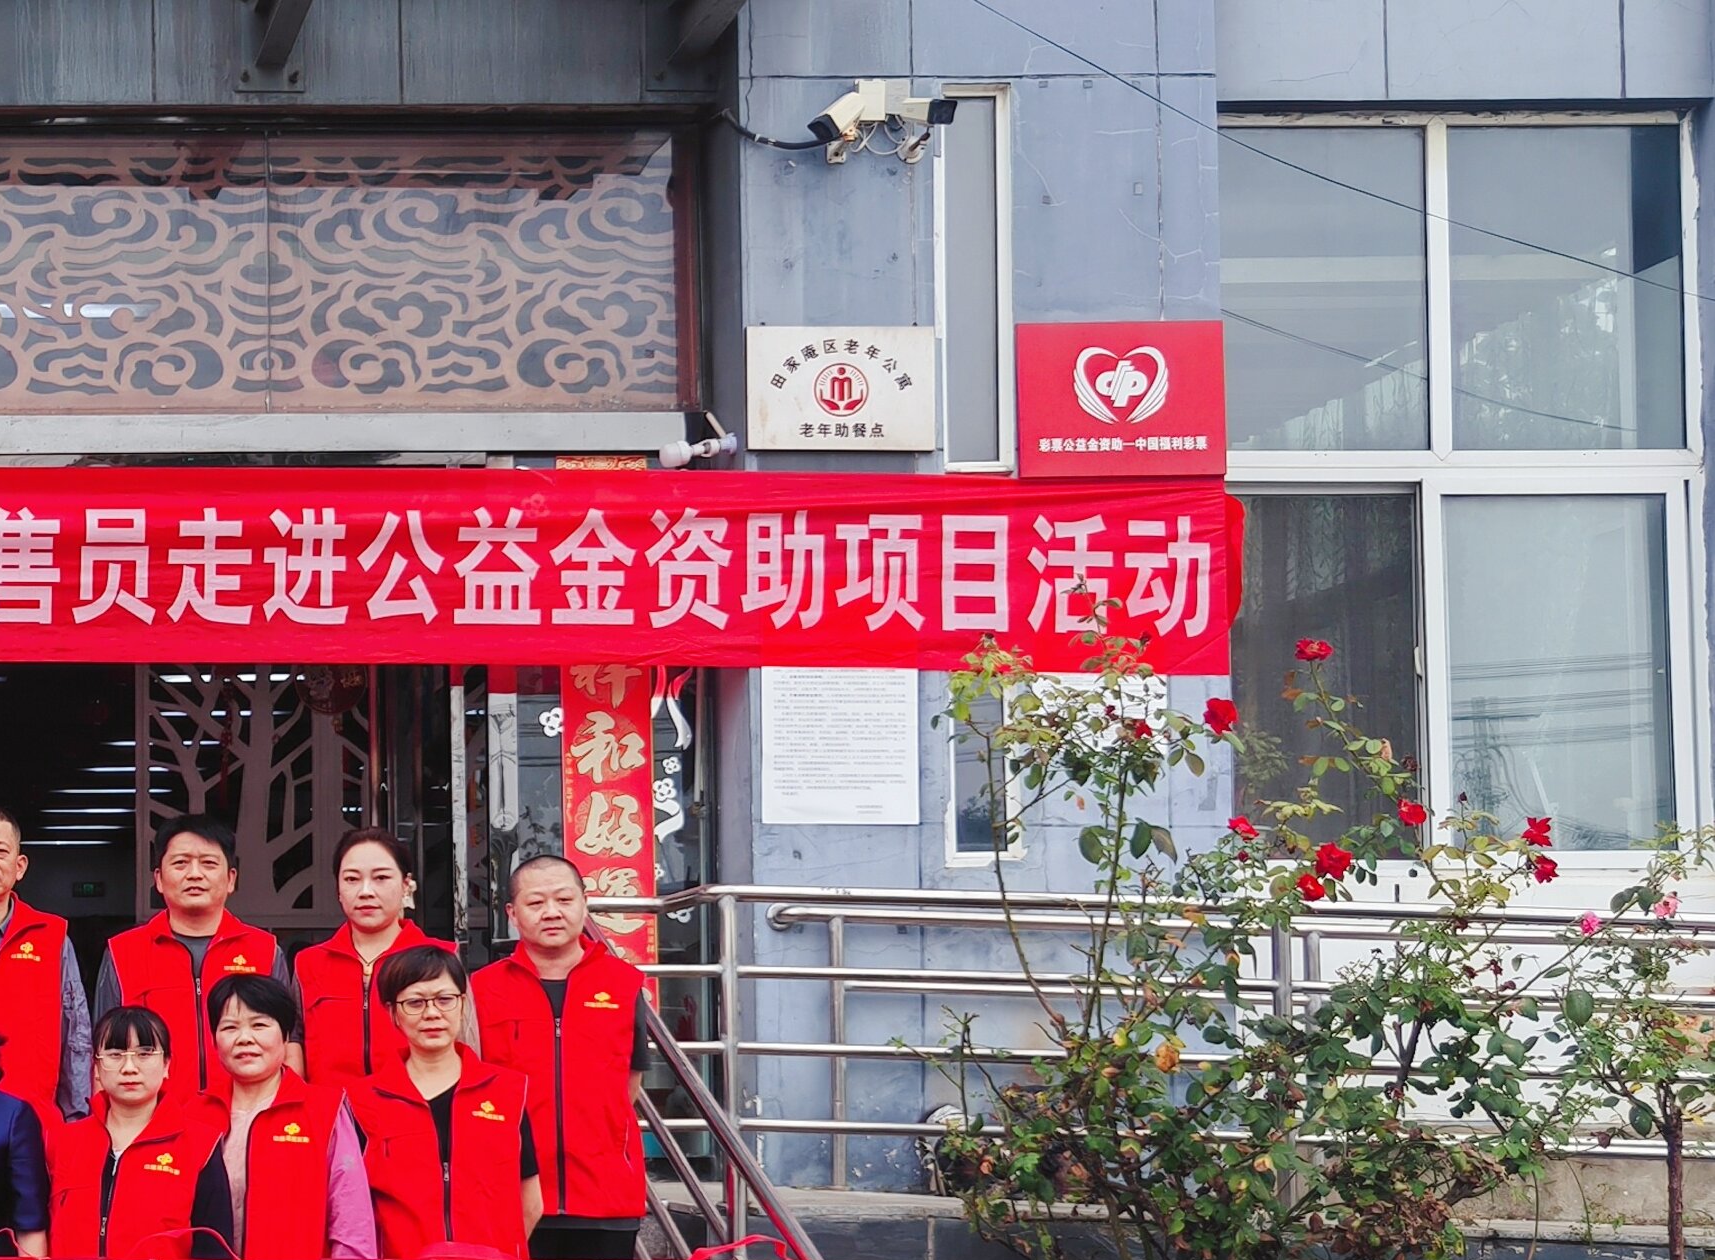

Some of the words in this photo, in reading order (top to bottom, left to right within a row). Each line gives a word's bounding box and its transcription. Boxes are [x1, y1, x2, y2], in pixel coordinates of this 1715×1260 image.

[769, 338, 915, 391] 田家庵区老年公寓
[799, 422, 885, 439] 老年助餐点
